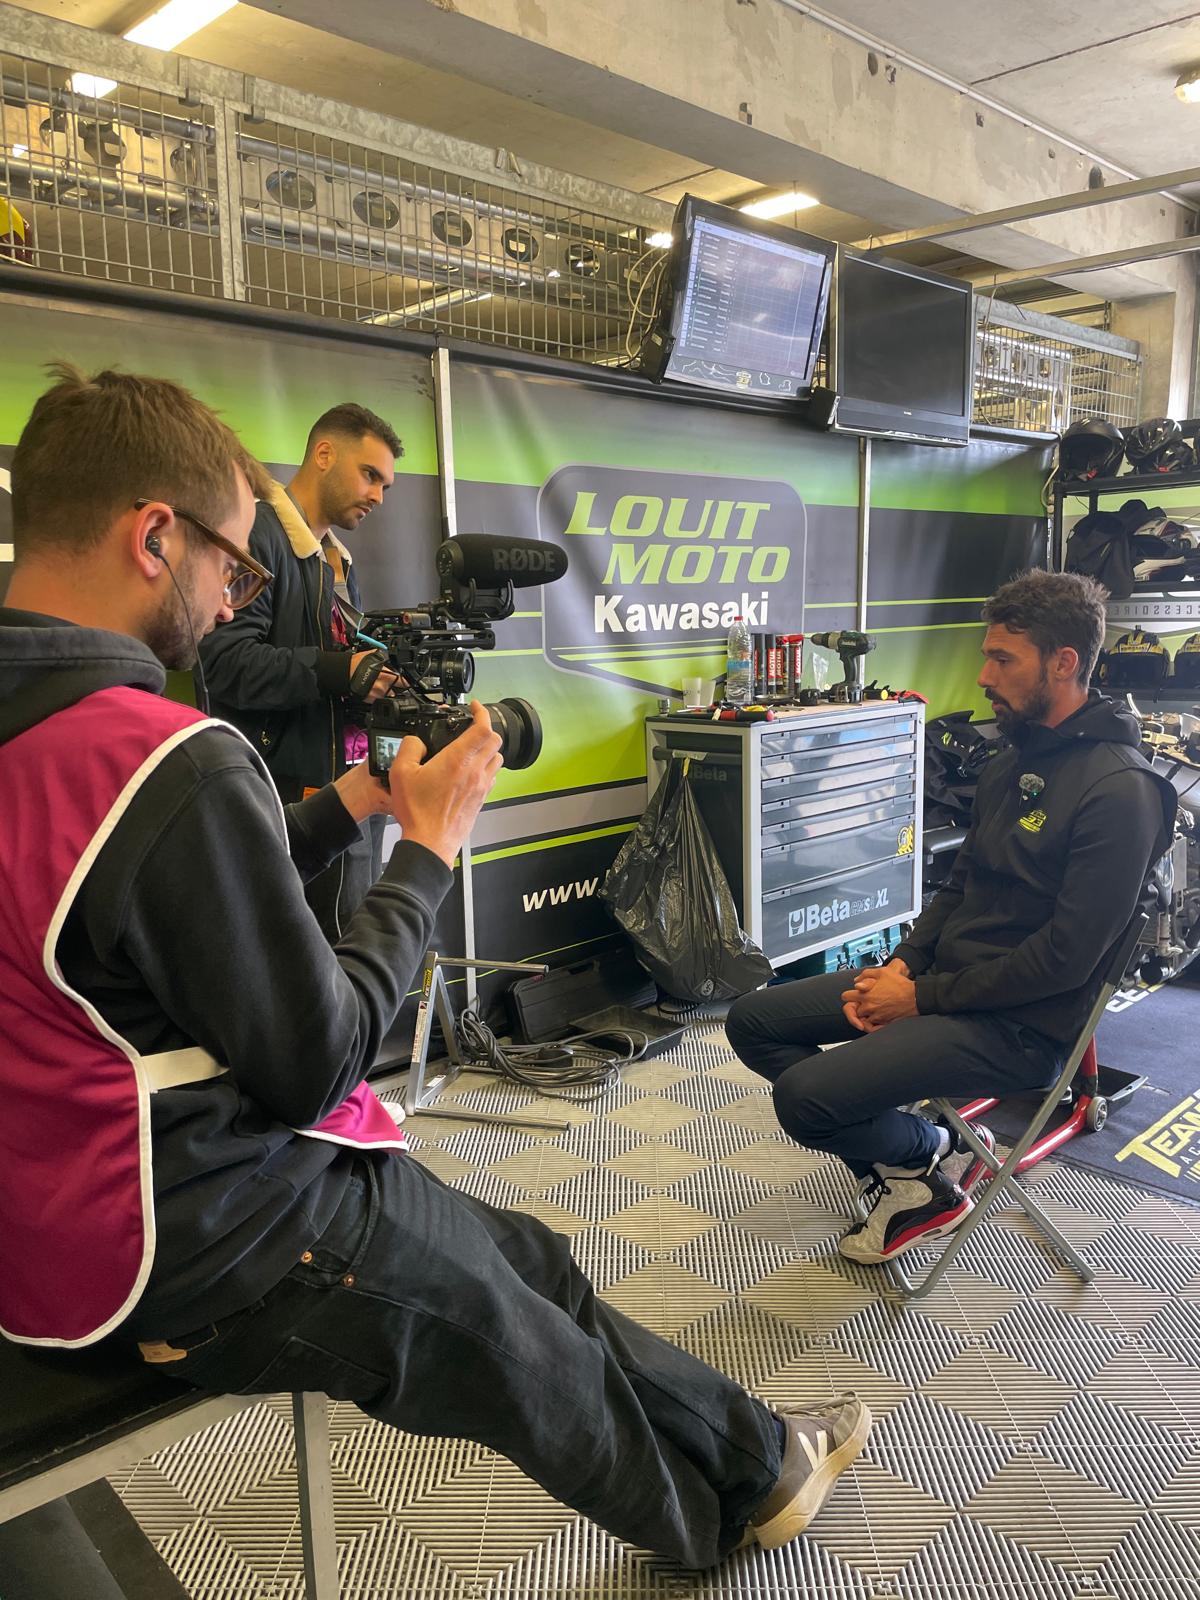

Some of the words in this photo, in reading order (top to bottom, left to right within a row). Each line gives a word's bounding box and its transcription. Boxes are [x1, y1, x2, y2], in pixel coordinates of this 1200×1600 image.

[564, 491, 771, 540] LOUIT
[492, 548, 556, 573] RØDE
[601, 543, 791, 585] MOTO
[594, 591, 769, 633] Kawasaki
[768, 650, 776, 677] MOTUL
[693, 764, 728, 781] Beta
[806, 898, 850, 932] Beta
[875, 887, 889, 909] XL
